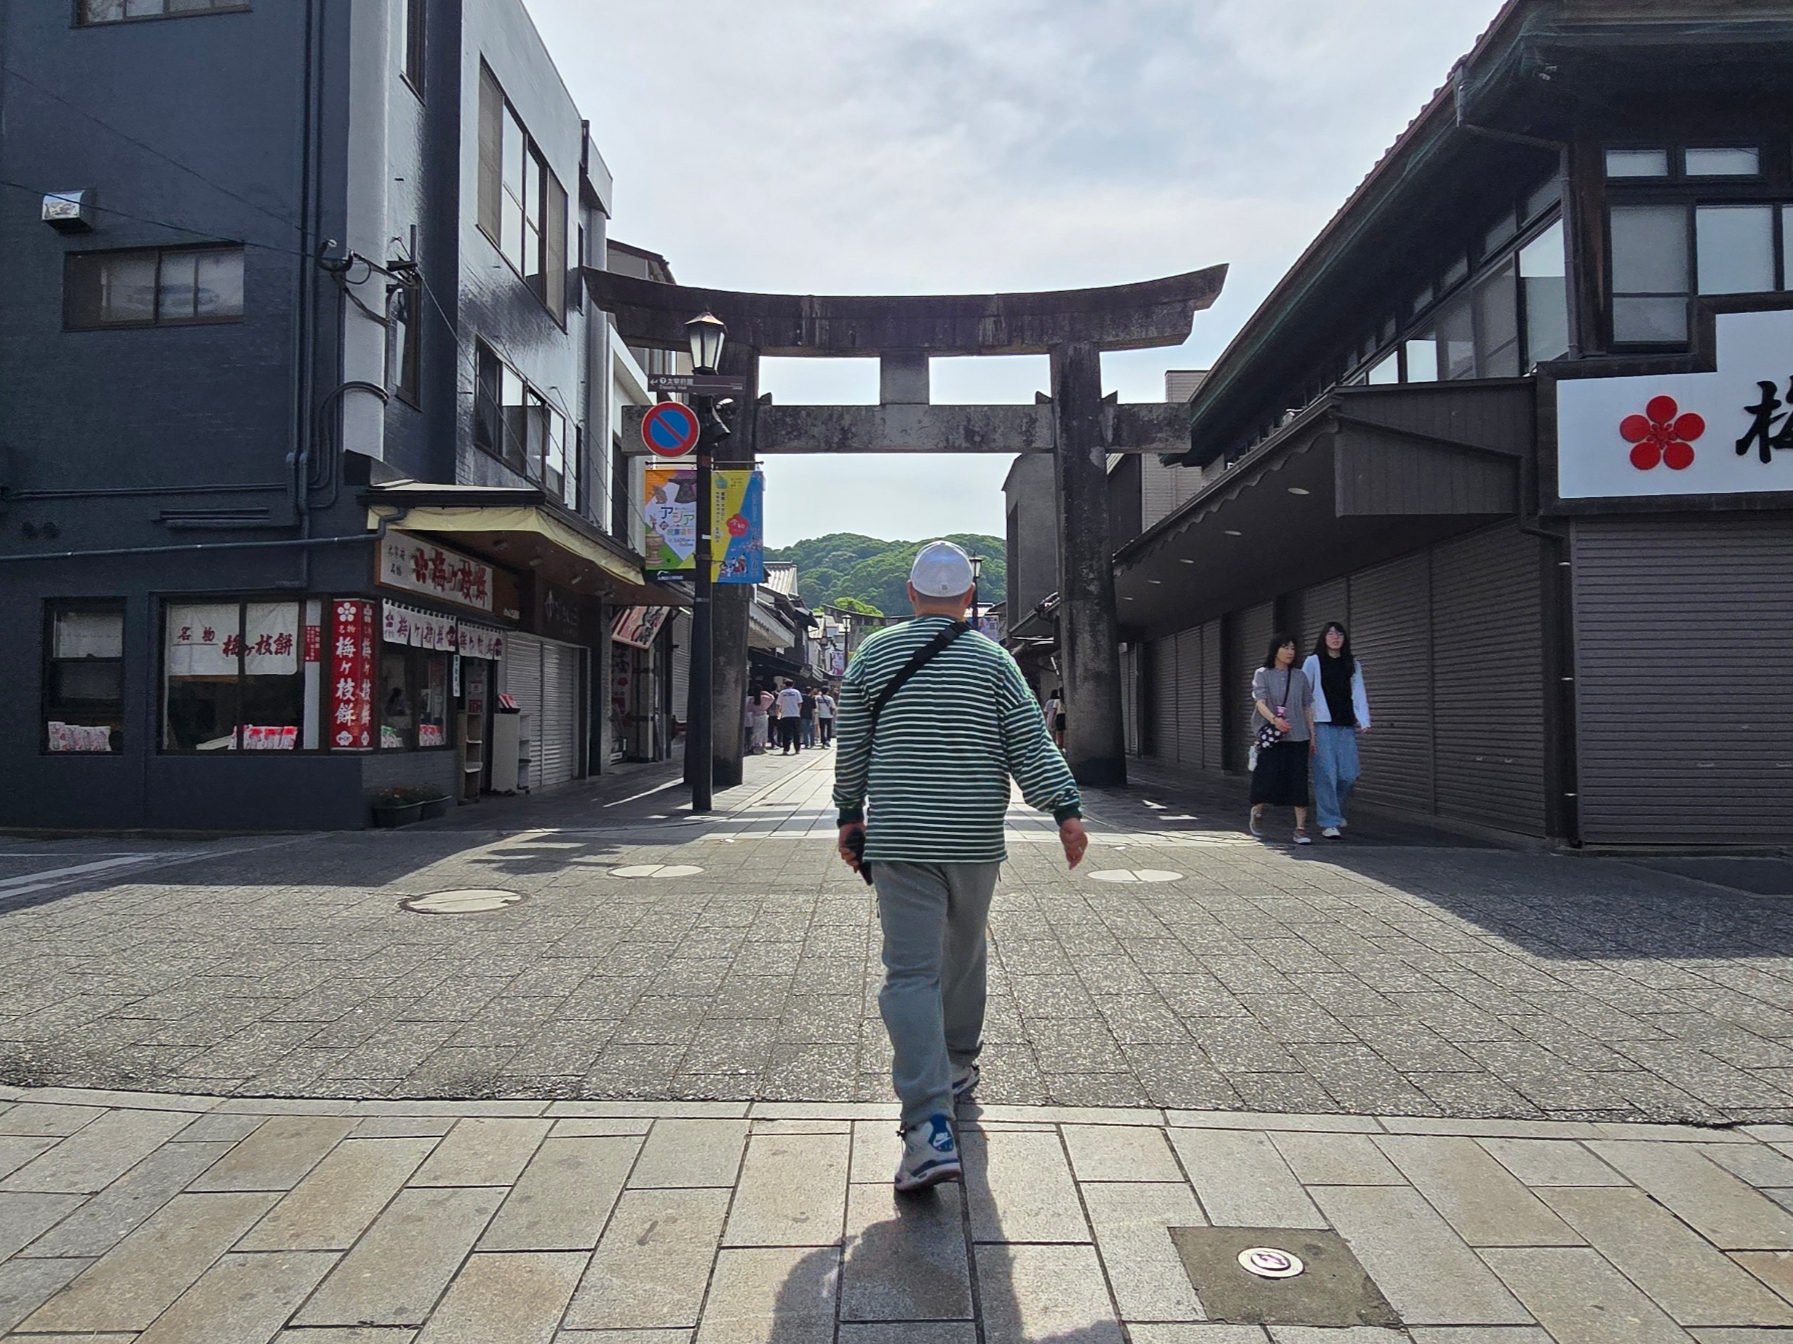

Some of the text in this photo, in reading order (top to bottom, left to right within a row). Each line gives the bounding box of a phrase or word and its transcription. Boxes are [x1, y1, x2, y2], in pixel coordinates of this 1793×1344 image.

[660, 506, 695, 526] アジア
[178, 626, 215, 642] 名物
